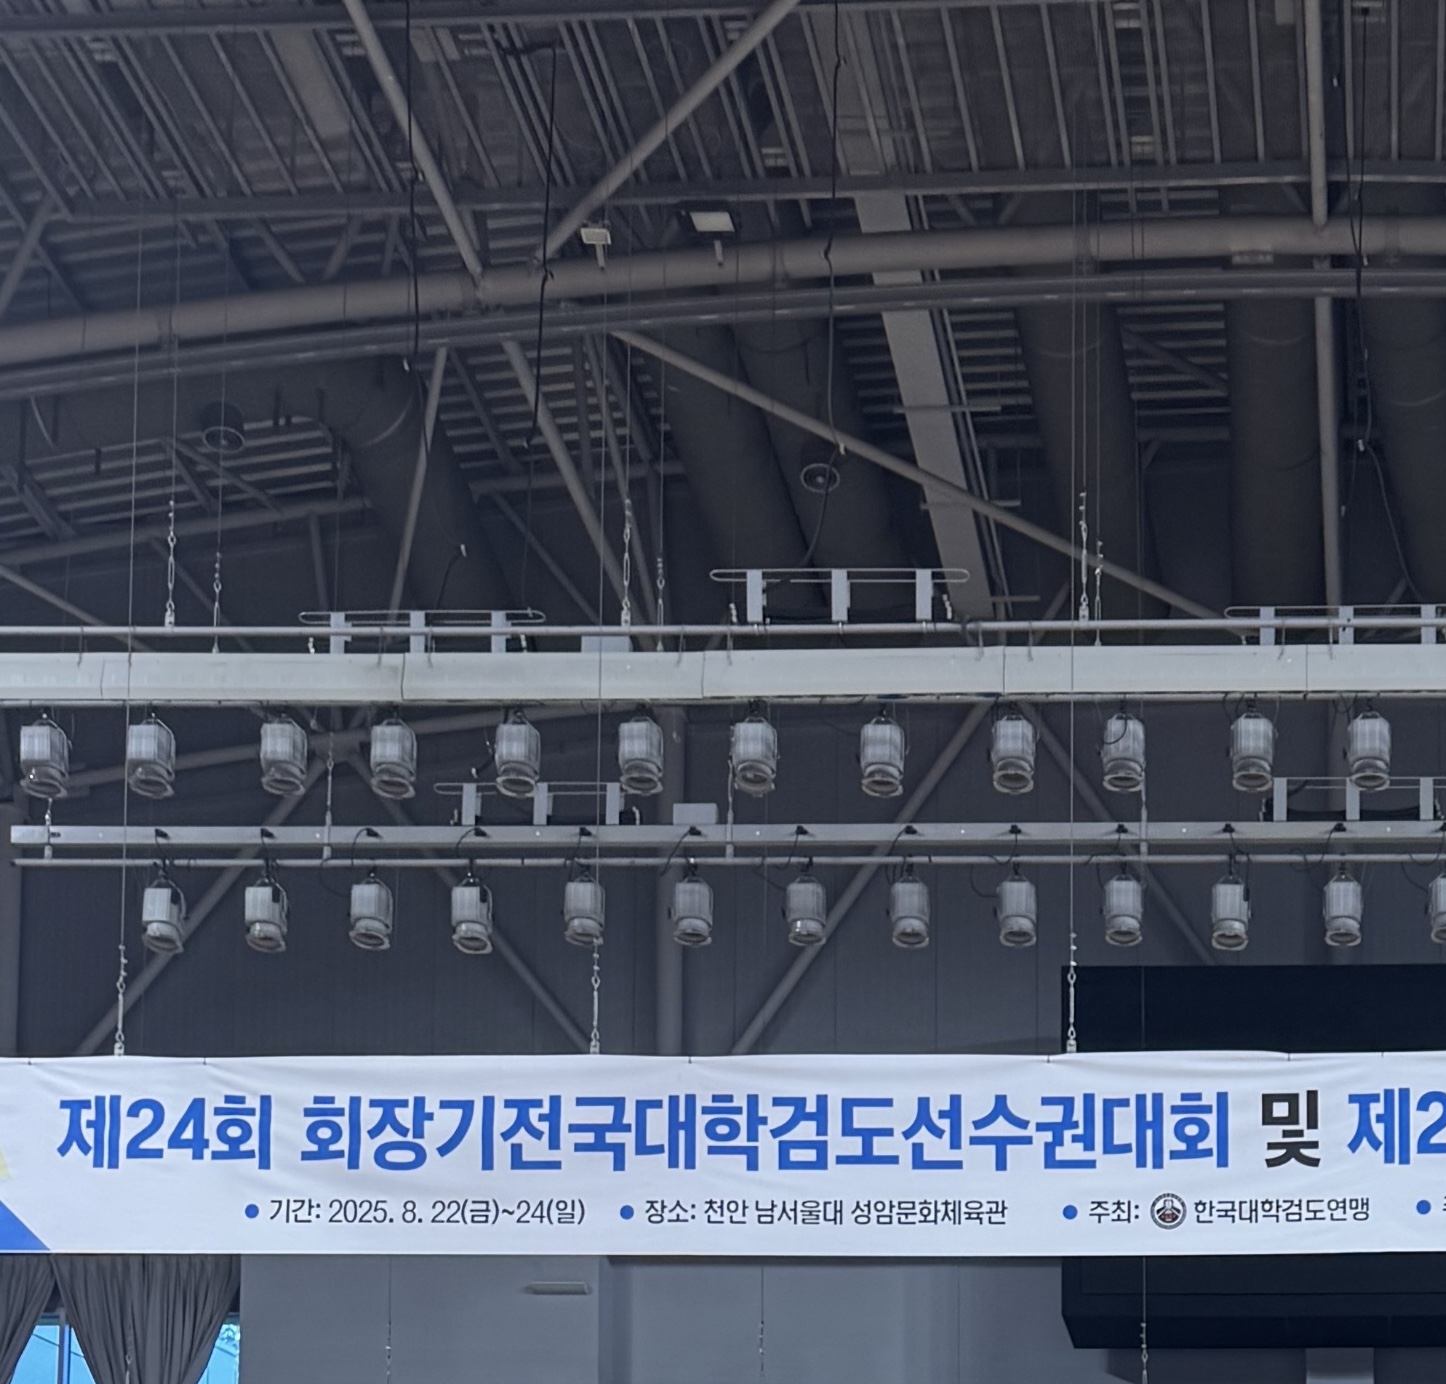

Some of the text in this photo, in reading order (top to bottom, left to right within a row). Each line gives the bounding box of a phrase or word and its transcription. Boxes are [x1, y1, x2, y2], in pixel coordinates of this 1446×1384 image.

[57, 1095, 272, 1170] 제24회
[301, 1092, 1228, 1171] 회장기전국대학검도선수권대회
[1262, 1090, 1320, 1168] 및
[270, 1199, 585, 1225] 기간: 2025. 8. 22(금)~24(일)
[646, 1199, 1008, 1226] 장소: 천안 남서울대 성암문화체육관
[1089, 1198, 1370, 1223] 주최: 한국대학검도연맹
